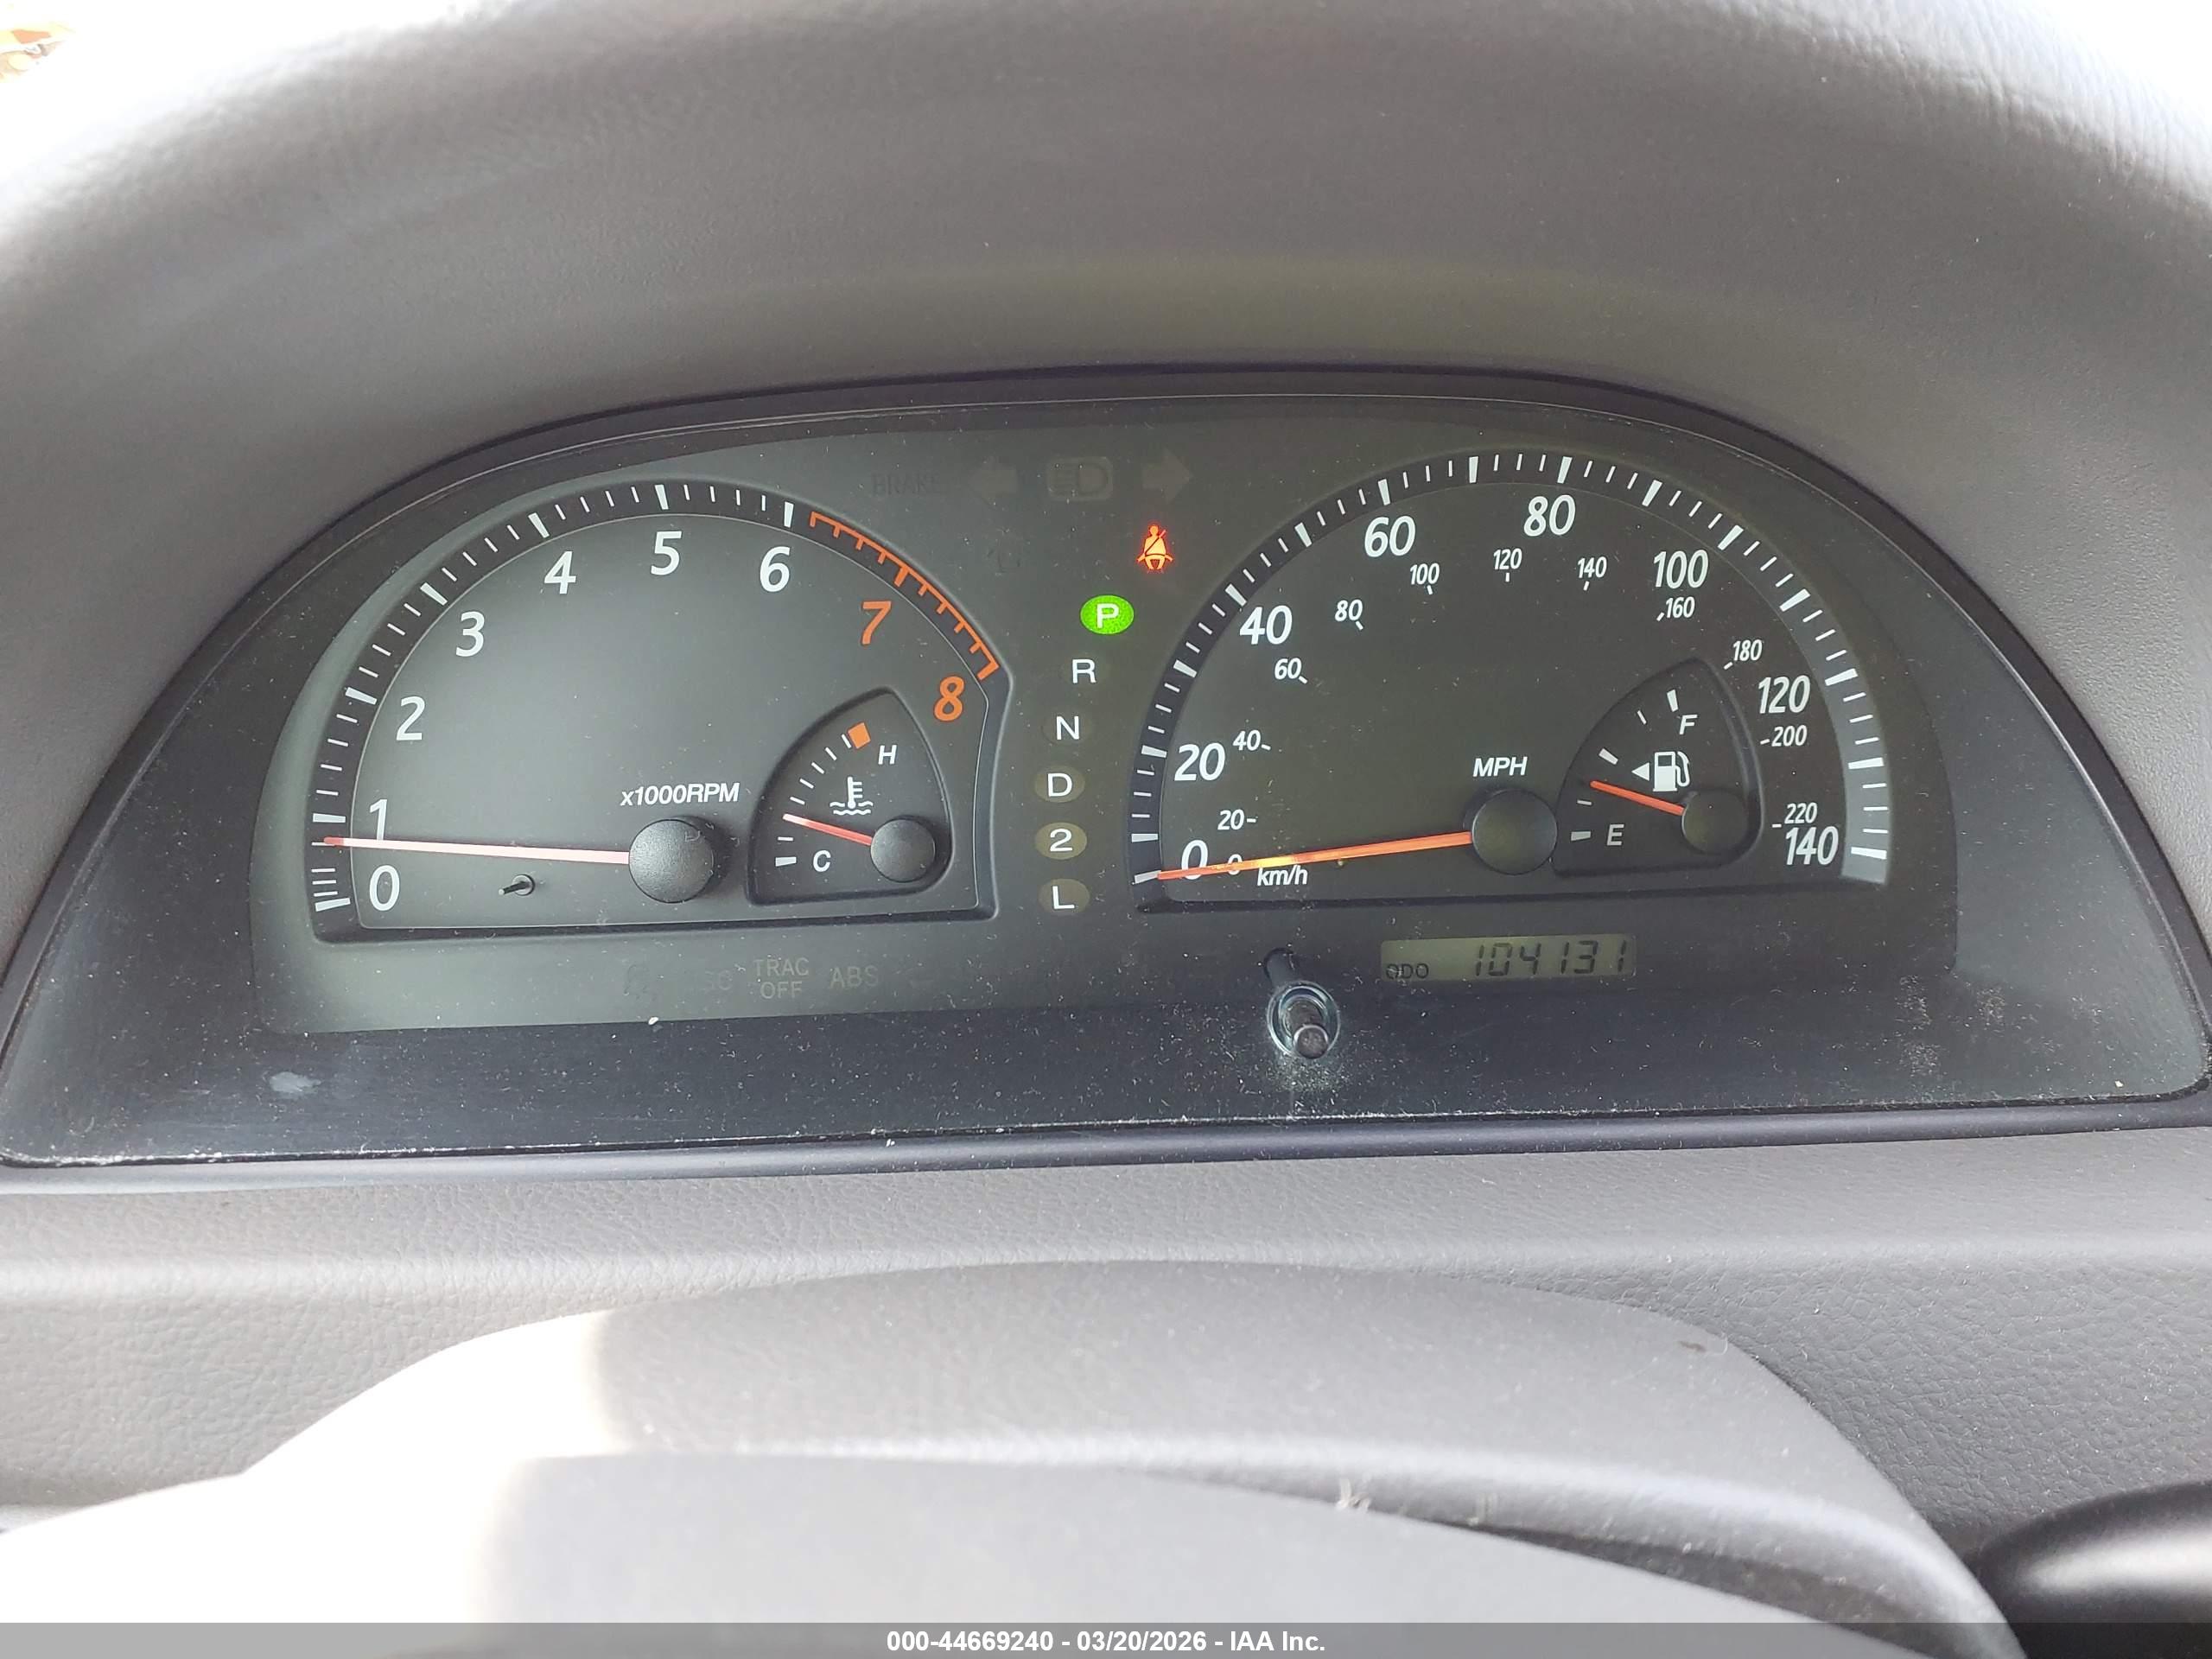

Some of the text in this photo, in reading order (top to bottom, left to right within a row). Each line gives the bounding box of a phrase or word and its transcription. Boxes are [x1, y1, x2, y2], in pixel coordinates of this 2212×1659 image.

[1523, 494, 1576, 537] 80
[1364, 515, 1416, 557] 60
[651, 531, 683, 575] 5
[1493, 548, 1522, 570] 120
[543, 550, 576, 594] 4
[760, 546, 791, 593] 6
[1409, 563, 1440, 585] 100
[1577, 556, 1607, 579] 140
[1653, 549, 1709, 589] 100
[1096, 603, 1120, 628] P
[1334, 599, 1363, 622] 80
[1665, 596, 1695, 619] 160
[455, 611, 485, 658] 3
[861, 601, 892, 645] 7
[1239, 605, 1293, 645] 40
[1732, 639, 1763, 662] 180
[1071, 658, 1096, 683] R
[1274, 658, 1302, 680] 60
[934, 676, 964, 721] 8
[1758, 675, 1811, 714] 120
[396, 696, 425, 741] 2
[1056, 715, 1080, 741] N
[1679, 714, 1698, 735] F
[1232, 729, 1262, 751] 40
[1771, 724, 1808, 747] 200
[878, 744, 897, 765] H
[1173, 742, 1226, 781] 20
[1472, 756, 1528, 778] MPH
[620, 782, 741, 806] x1000RPM
[1047, 772, 1072, 798] D
[369, 798, 388, 840] 1
[1217, 809, 1245, 830] 20
[1783, 802, 1818, 824] 220
[1049, 828, 1073, 852] 2
[1606, 823, 1624, 846] E
[1785, 825, 1839, 866] 140
[812, 849, 831, 873] C
[1181, 839, 1209, 880] 0
[369, 864, 400, 912] 0
[1256, 866, 1308, 887] km/h
[1052, 886, 1075, 910] L
[754, 957, 810, 977] TRAC
[1385, 938, 1628, 981] ODO 104131
[830, 965, 879, 989] ABS
[760, 980, 803, 1000] OFF
